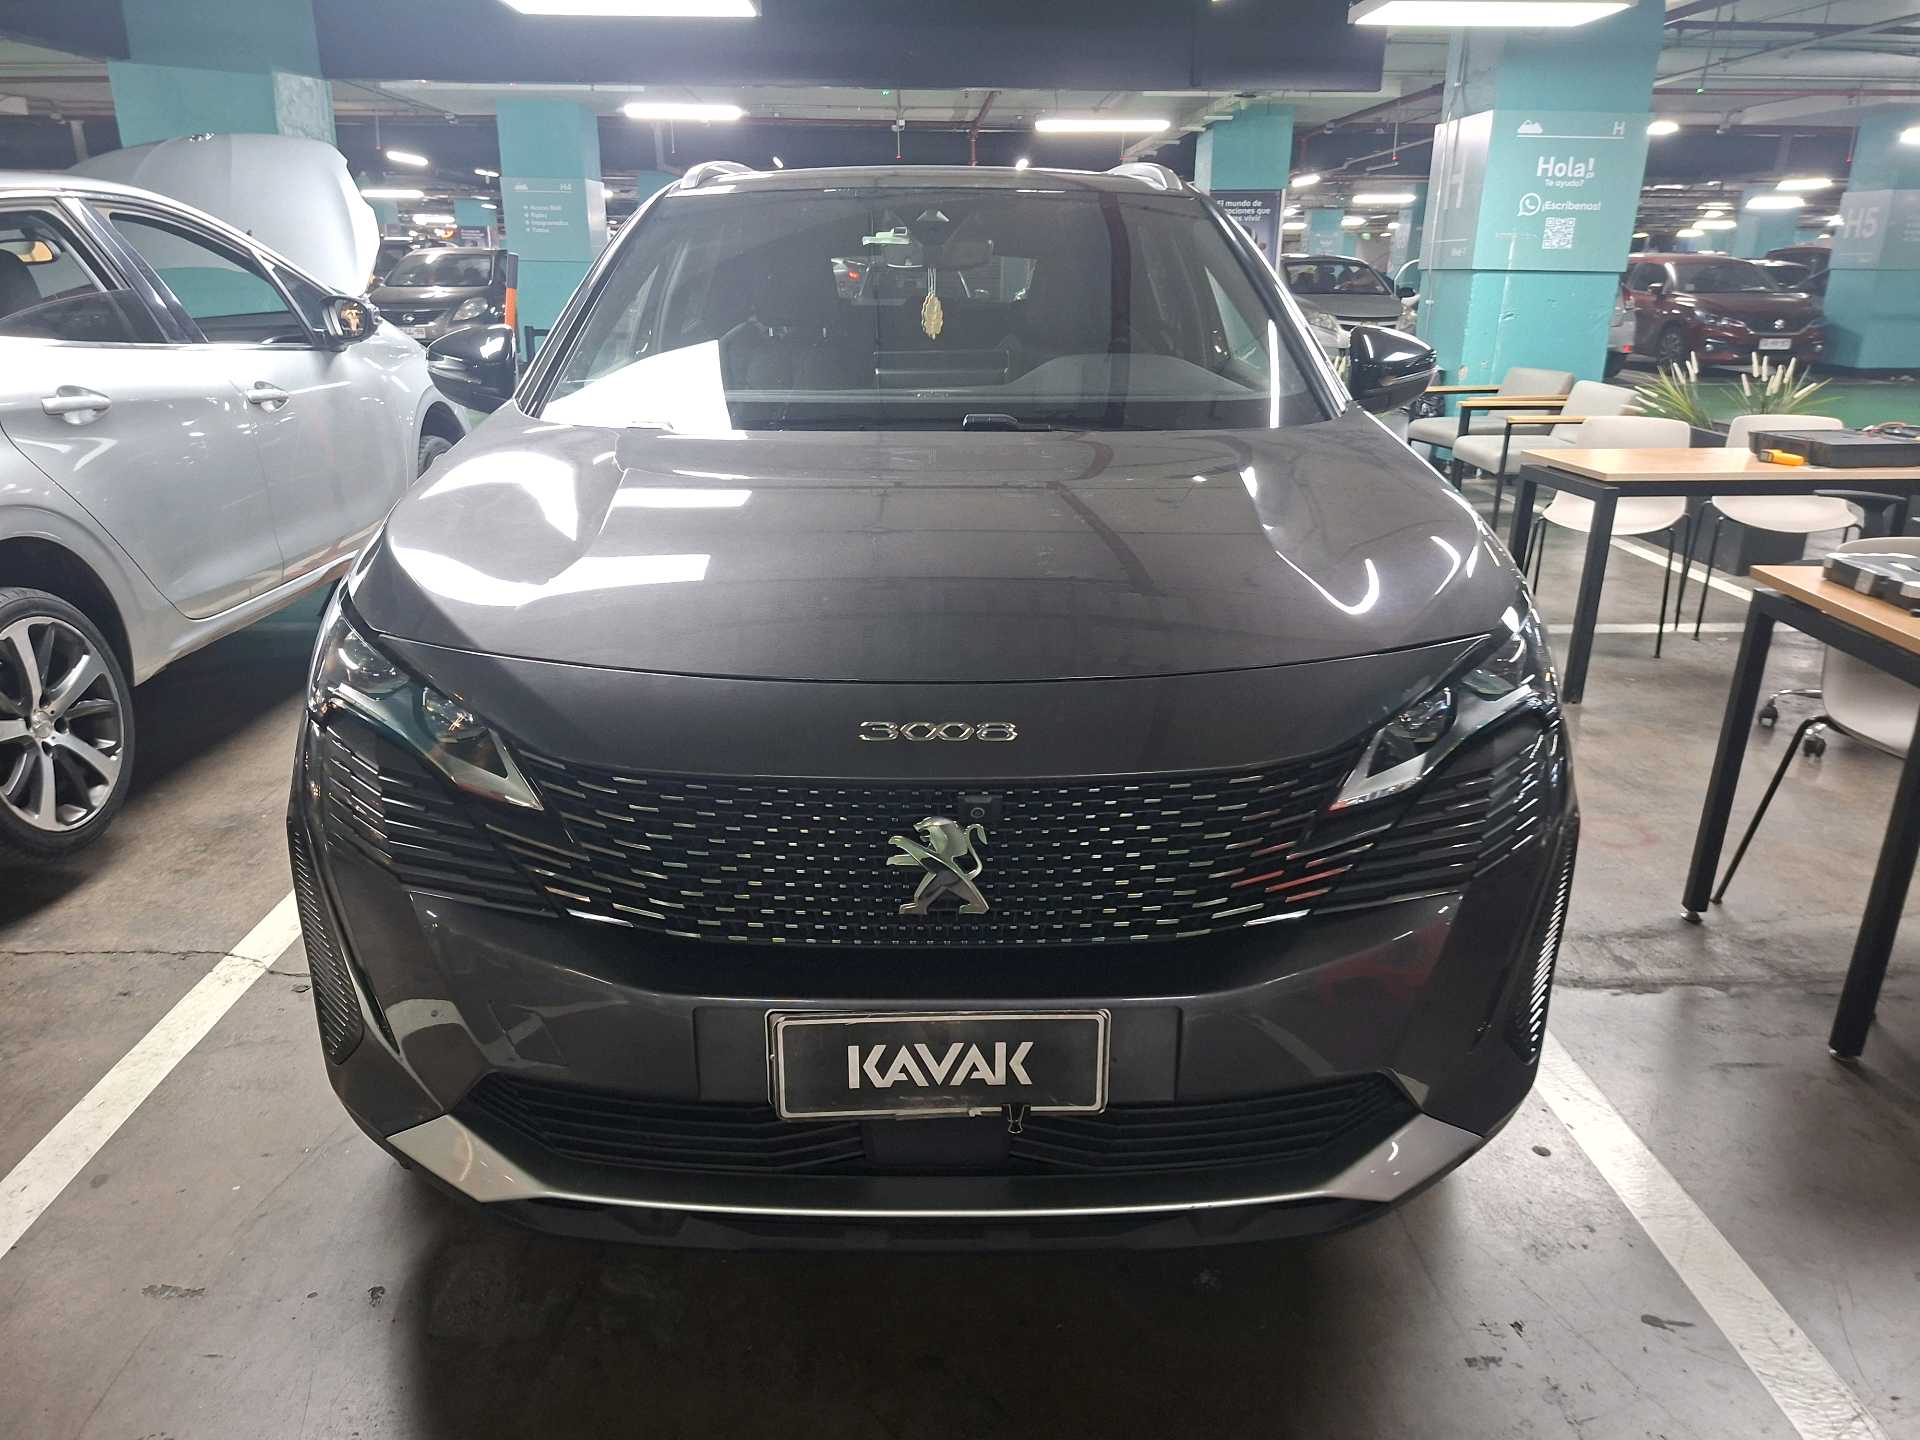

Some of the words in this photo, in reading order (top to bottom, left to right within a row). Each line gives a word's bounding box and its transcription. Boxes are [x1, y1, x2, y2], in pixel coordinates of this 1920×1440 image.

[1612, 121, 1625, 135] H
[1536, 156, 1595, 178] Hola!
[1256, 208, 1271, 216] que
[1843, 208, 1881, 240] H5
[858, 720, 1018, 742] 3008
[847, 1041, 1034, 1089] KAVAK
